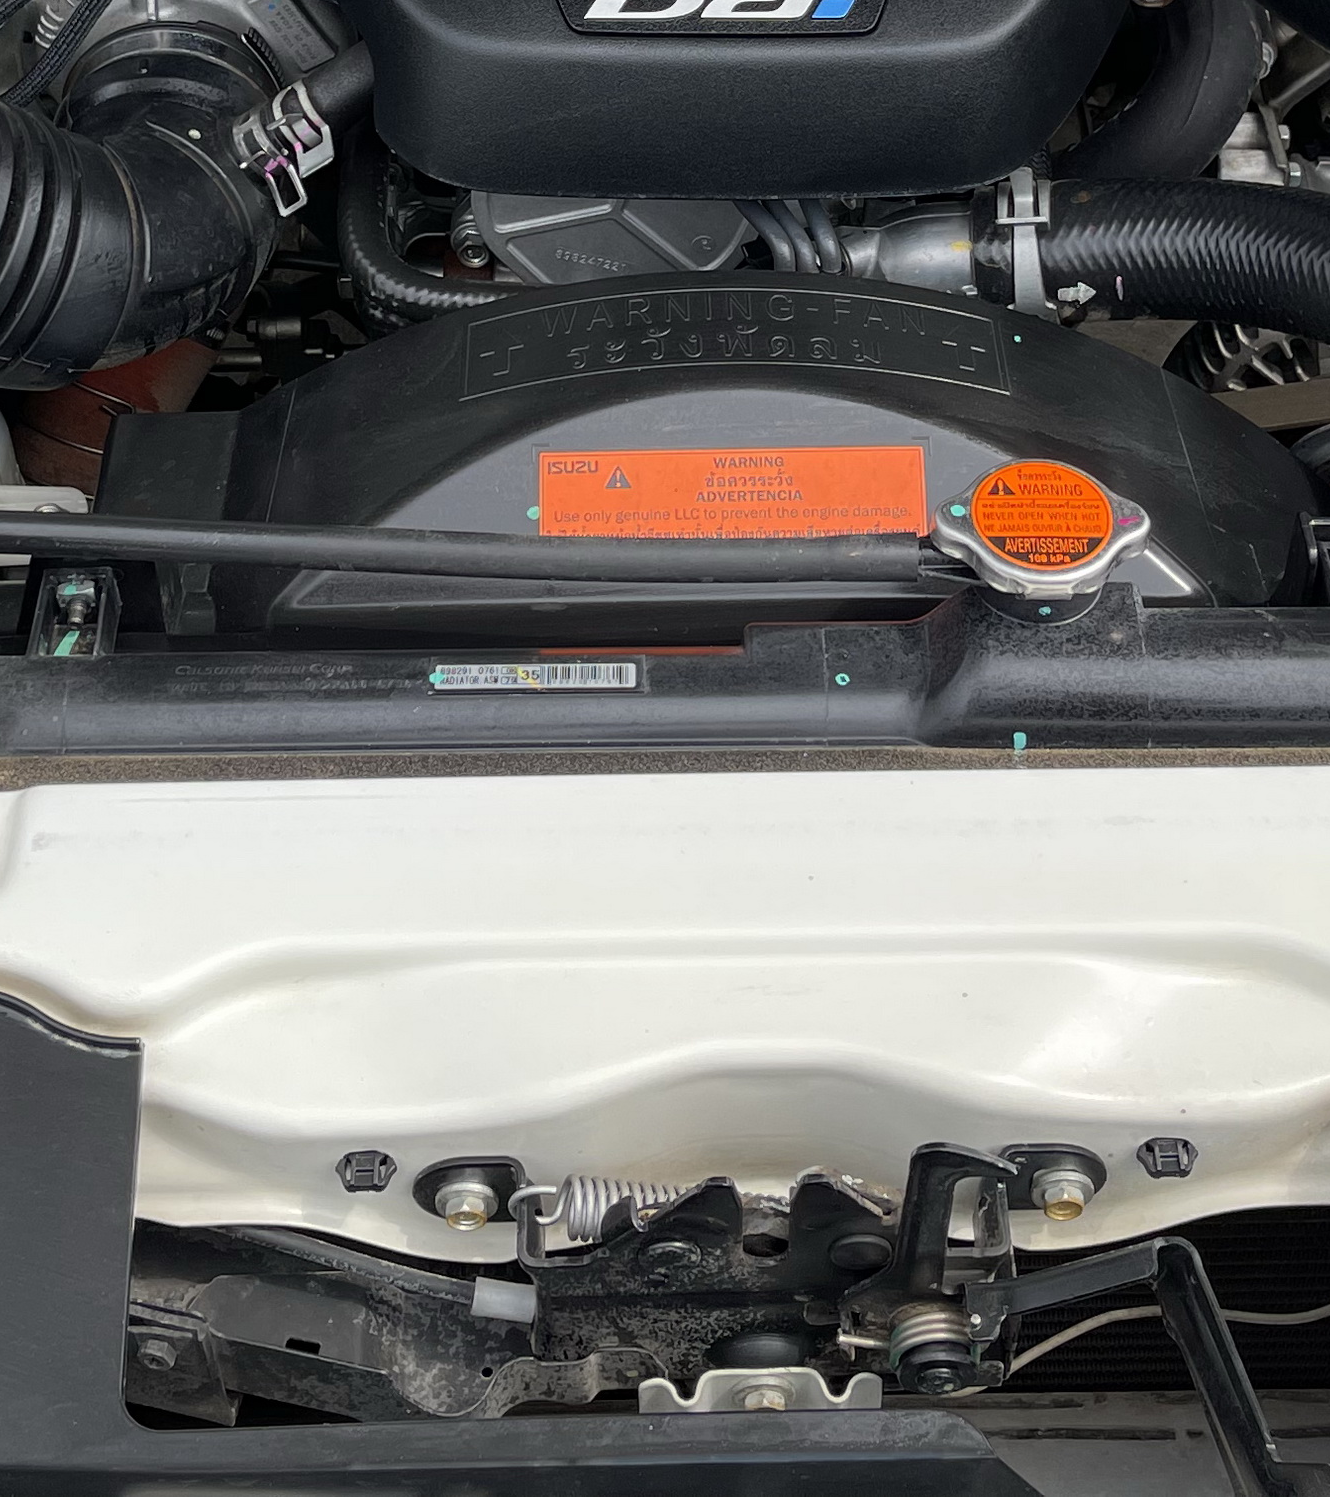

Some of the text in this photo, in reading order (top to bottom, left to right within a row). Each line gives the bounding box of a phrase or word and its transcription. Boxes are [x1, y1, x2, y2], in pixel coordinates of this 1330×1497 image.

[566, 325, 882, 371] ระวังพัดลม
[547, 460, 599, 475] ISUZU
[713, 456, 785, 470] WARNING
[704, 468, 794, 488] ข้อควรระวัง
[696, 489, 804, 503] ADVERTENCIA
[1018, 483, 1084, 497] WARNING
[553, 505, 912, 525] Use only genuine LLC to prevent the engine damage.
[982, 511, 1101, 521] NEVER OPEN WHEN HOT
[983, 523, 994, 532] NE
[997, 523, 1030, 533] JAMAIS
[1032, 523, 1064, 533] OUVRIR
[1073, 523, 1102, 534] CHAUD
[1004, 537, 1089, 554] AVERTISSEMENT
[1049, 553, 1071, 564] kPa
[521, 669, 540, 681] 35
